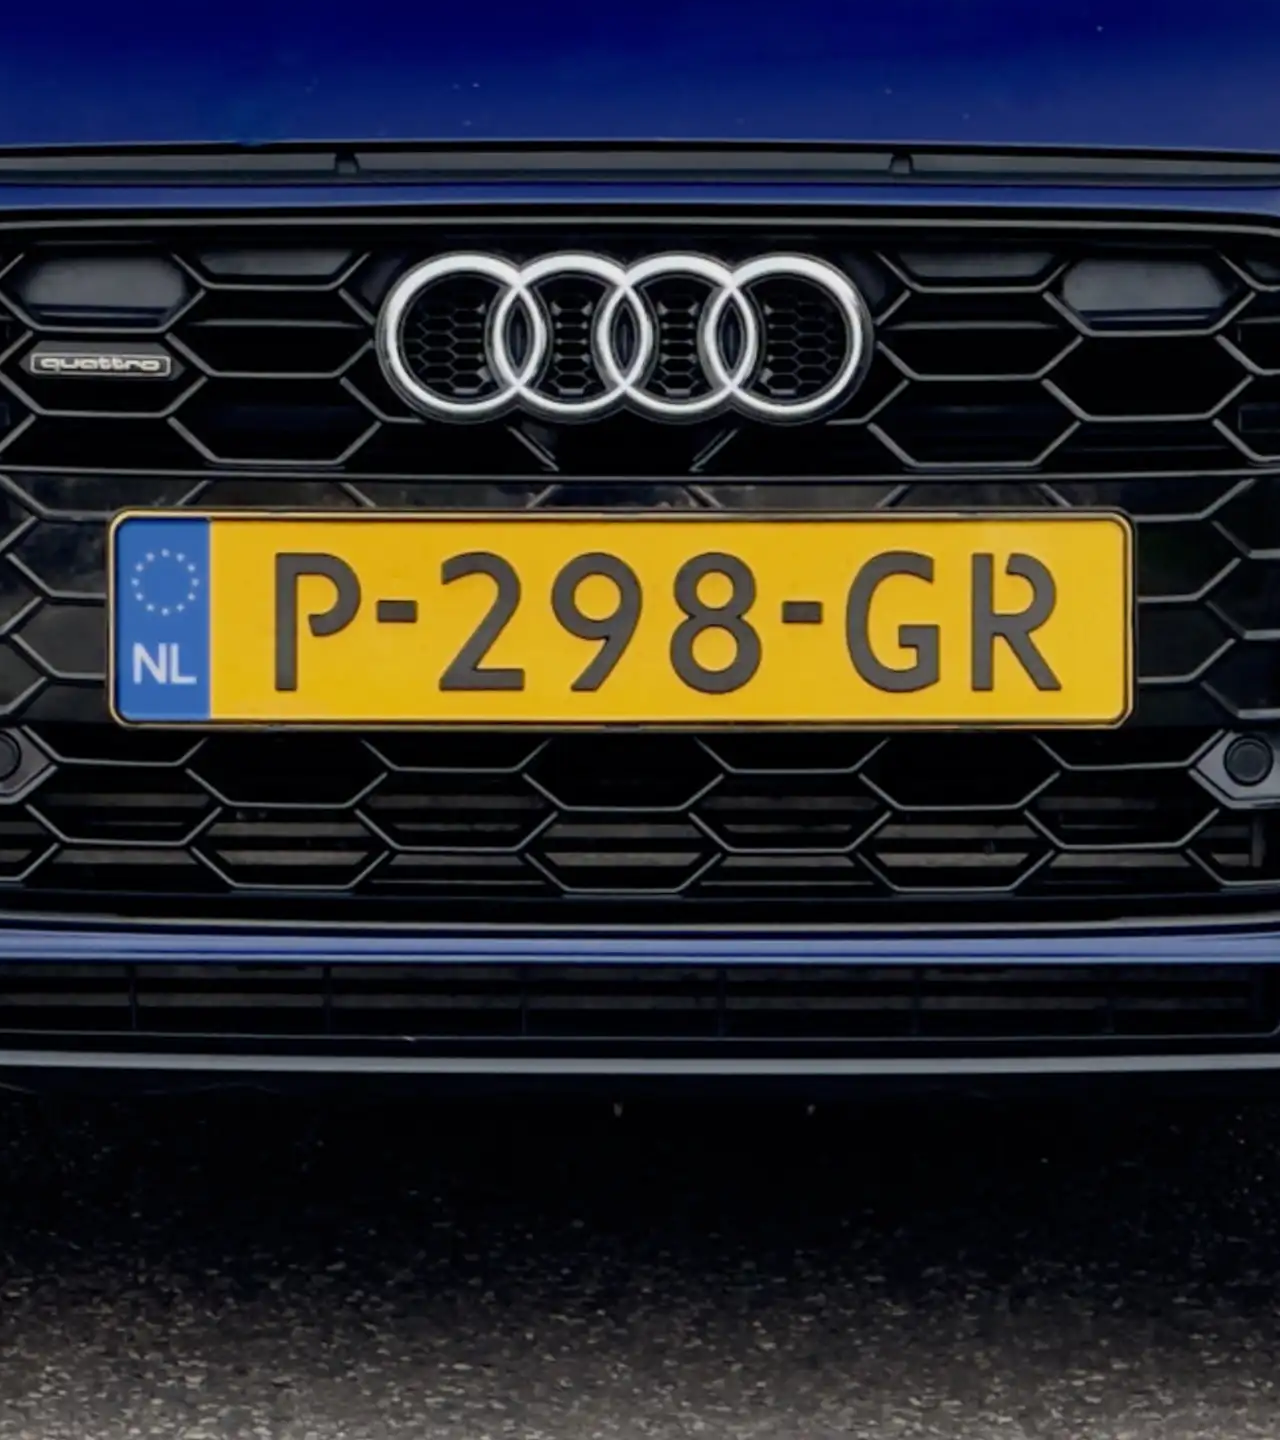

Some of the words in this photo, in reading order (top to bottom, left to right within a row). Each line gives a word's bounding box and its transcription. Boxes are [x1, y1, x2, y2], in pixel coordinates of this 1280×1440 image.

[40, 357, 160, 373] quattro
[273, 549, 1062, 695] P-298-GR
[132, 643, 196, 684] NL
